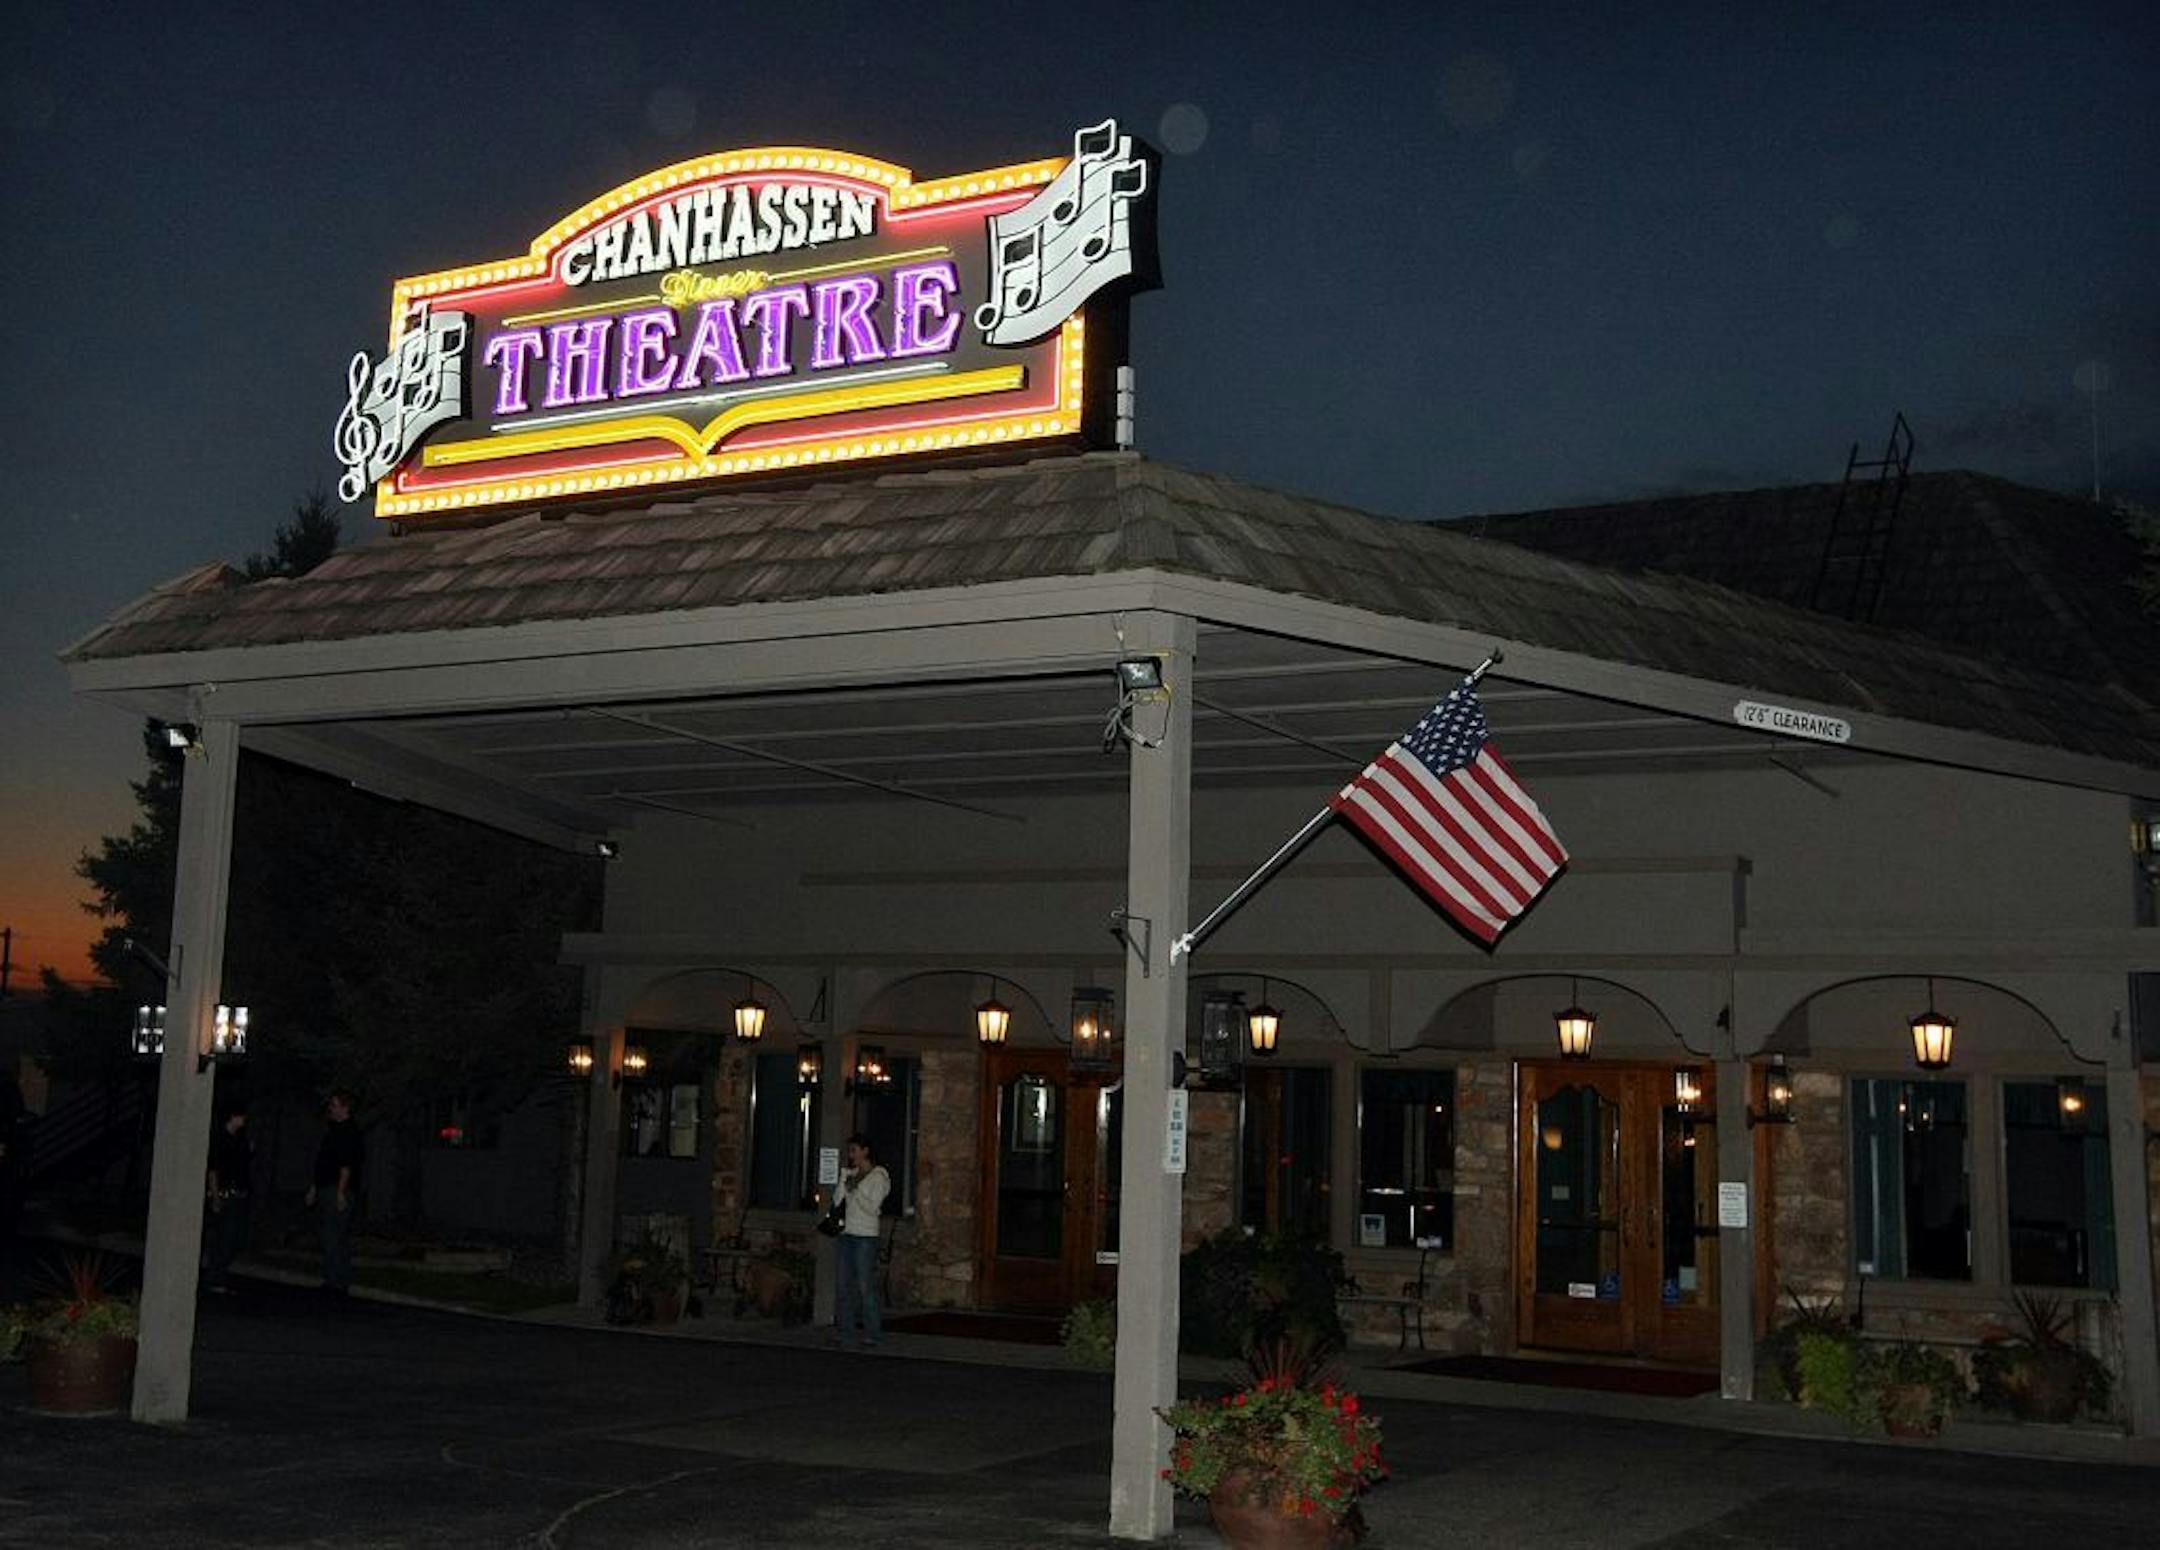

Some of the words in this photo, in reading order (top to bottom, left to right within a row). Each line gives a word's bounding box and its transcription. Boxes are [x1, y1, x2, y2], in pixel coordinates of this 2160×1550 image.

[560, 183, 877, 287] CHANHASSEN
[659, 268, 770, 309] Dinner
[483, 260, 961, 416] THEATRE
[1773, 711, 1843, 738] CLEARANCE
